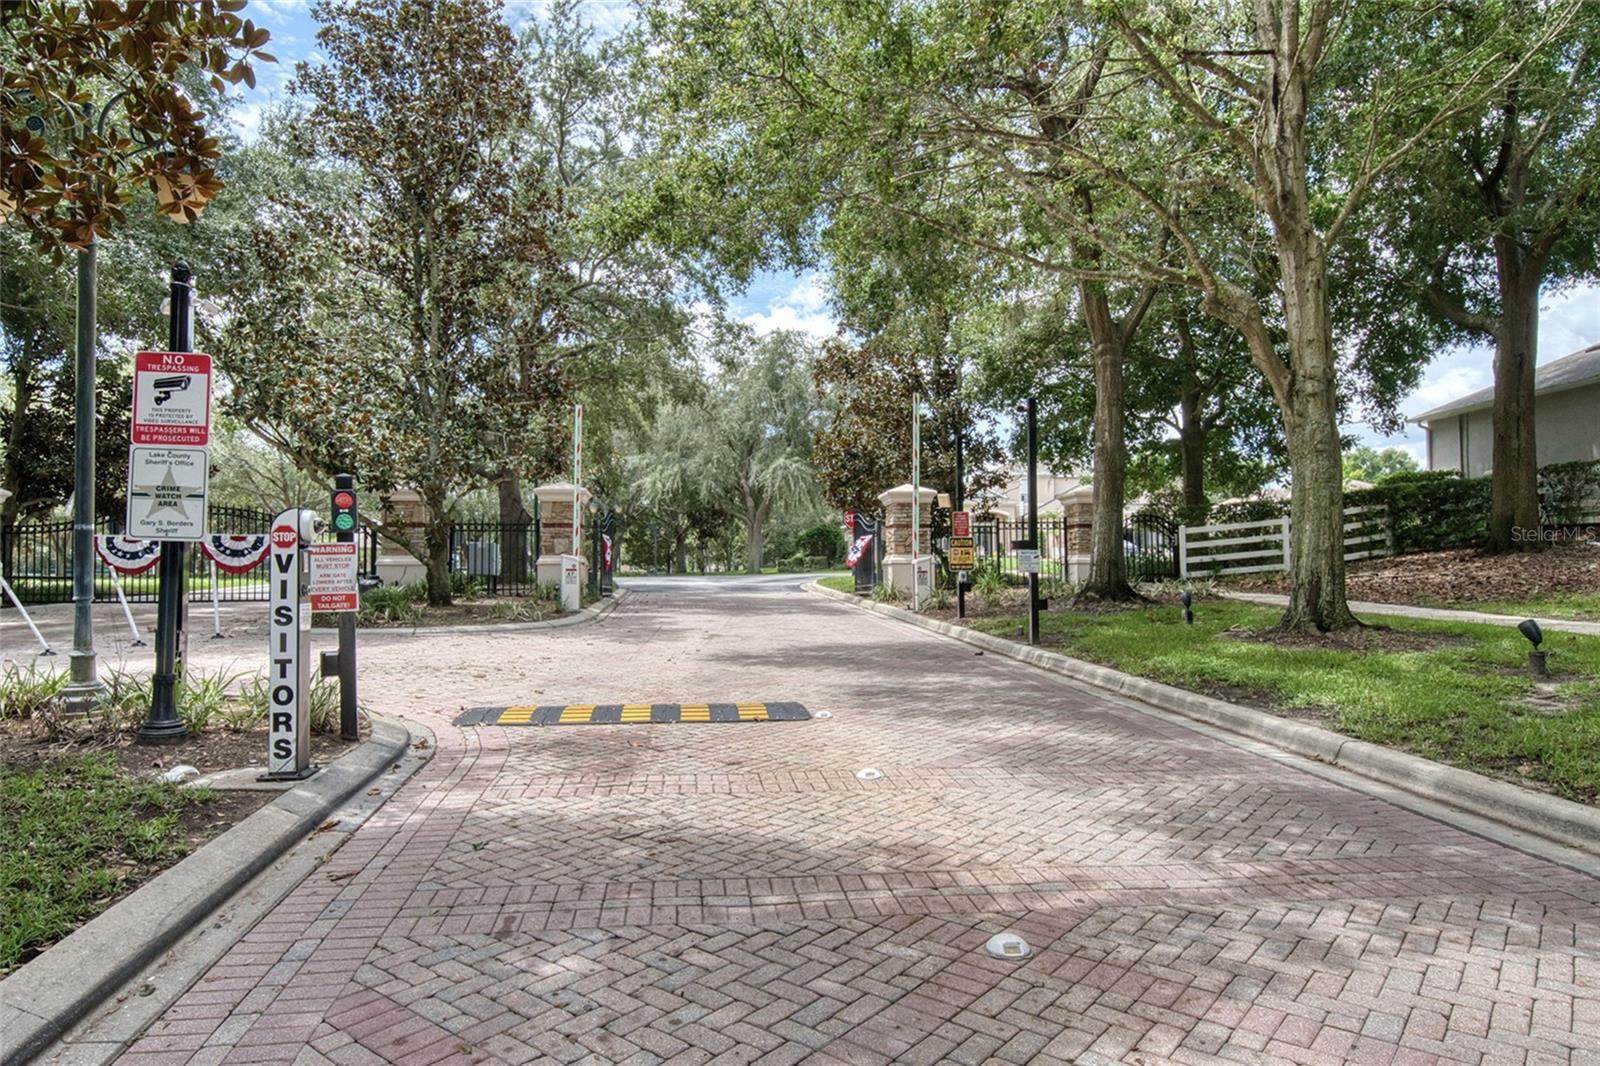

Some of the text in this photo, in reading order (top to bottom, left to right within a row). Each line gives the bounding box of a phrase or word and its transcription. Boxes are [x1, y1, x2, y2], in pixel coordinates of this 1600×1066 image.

[162, 355, 184, 365] NO
[148, 364, 200, 372] TRESPASSING
[136, 426, 187, 434] TRESPASSERS
[272, 532, 297, 542] STOP
[272, 554, 294, 759] VISITORS
